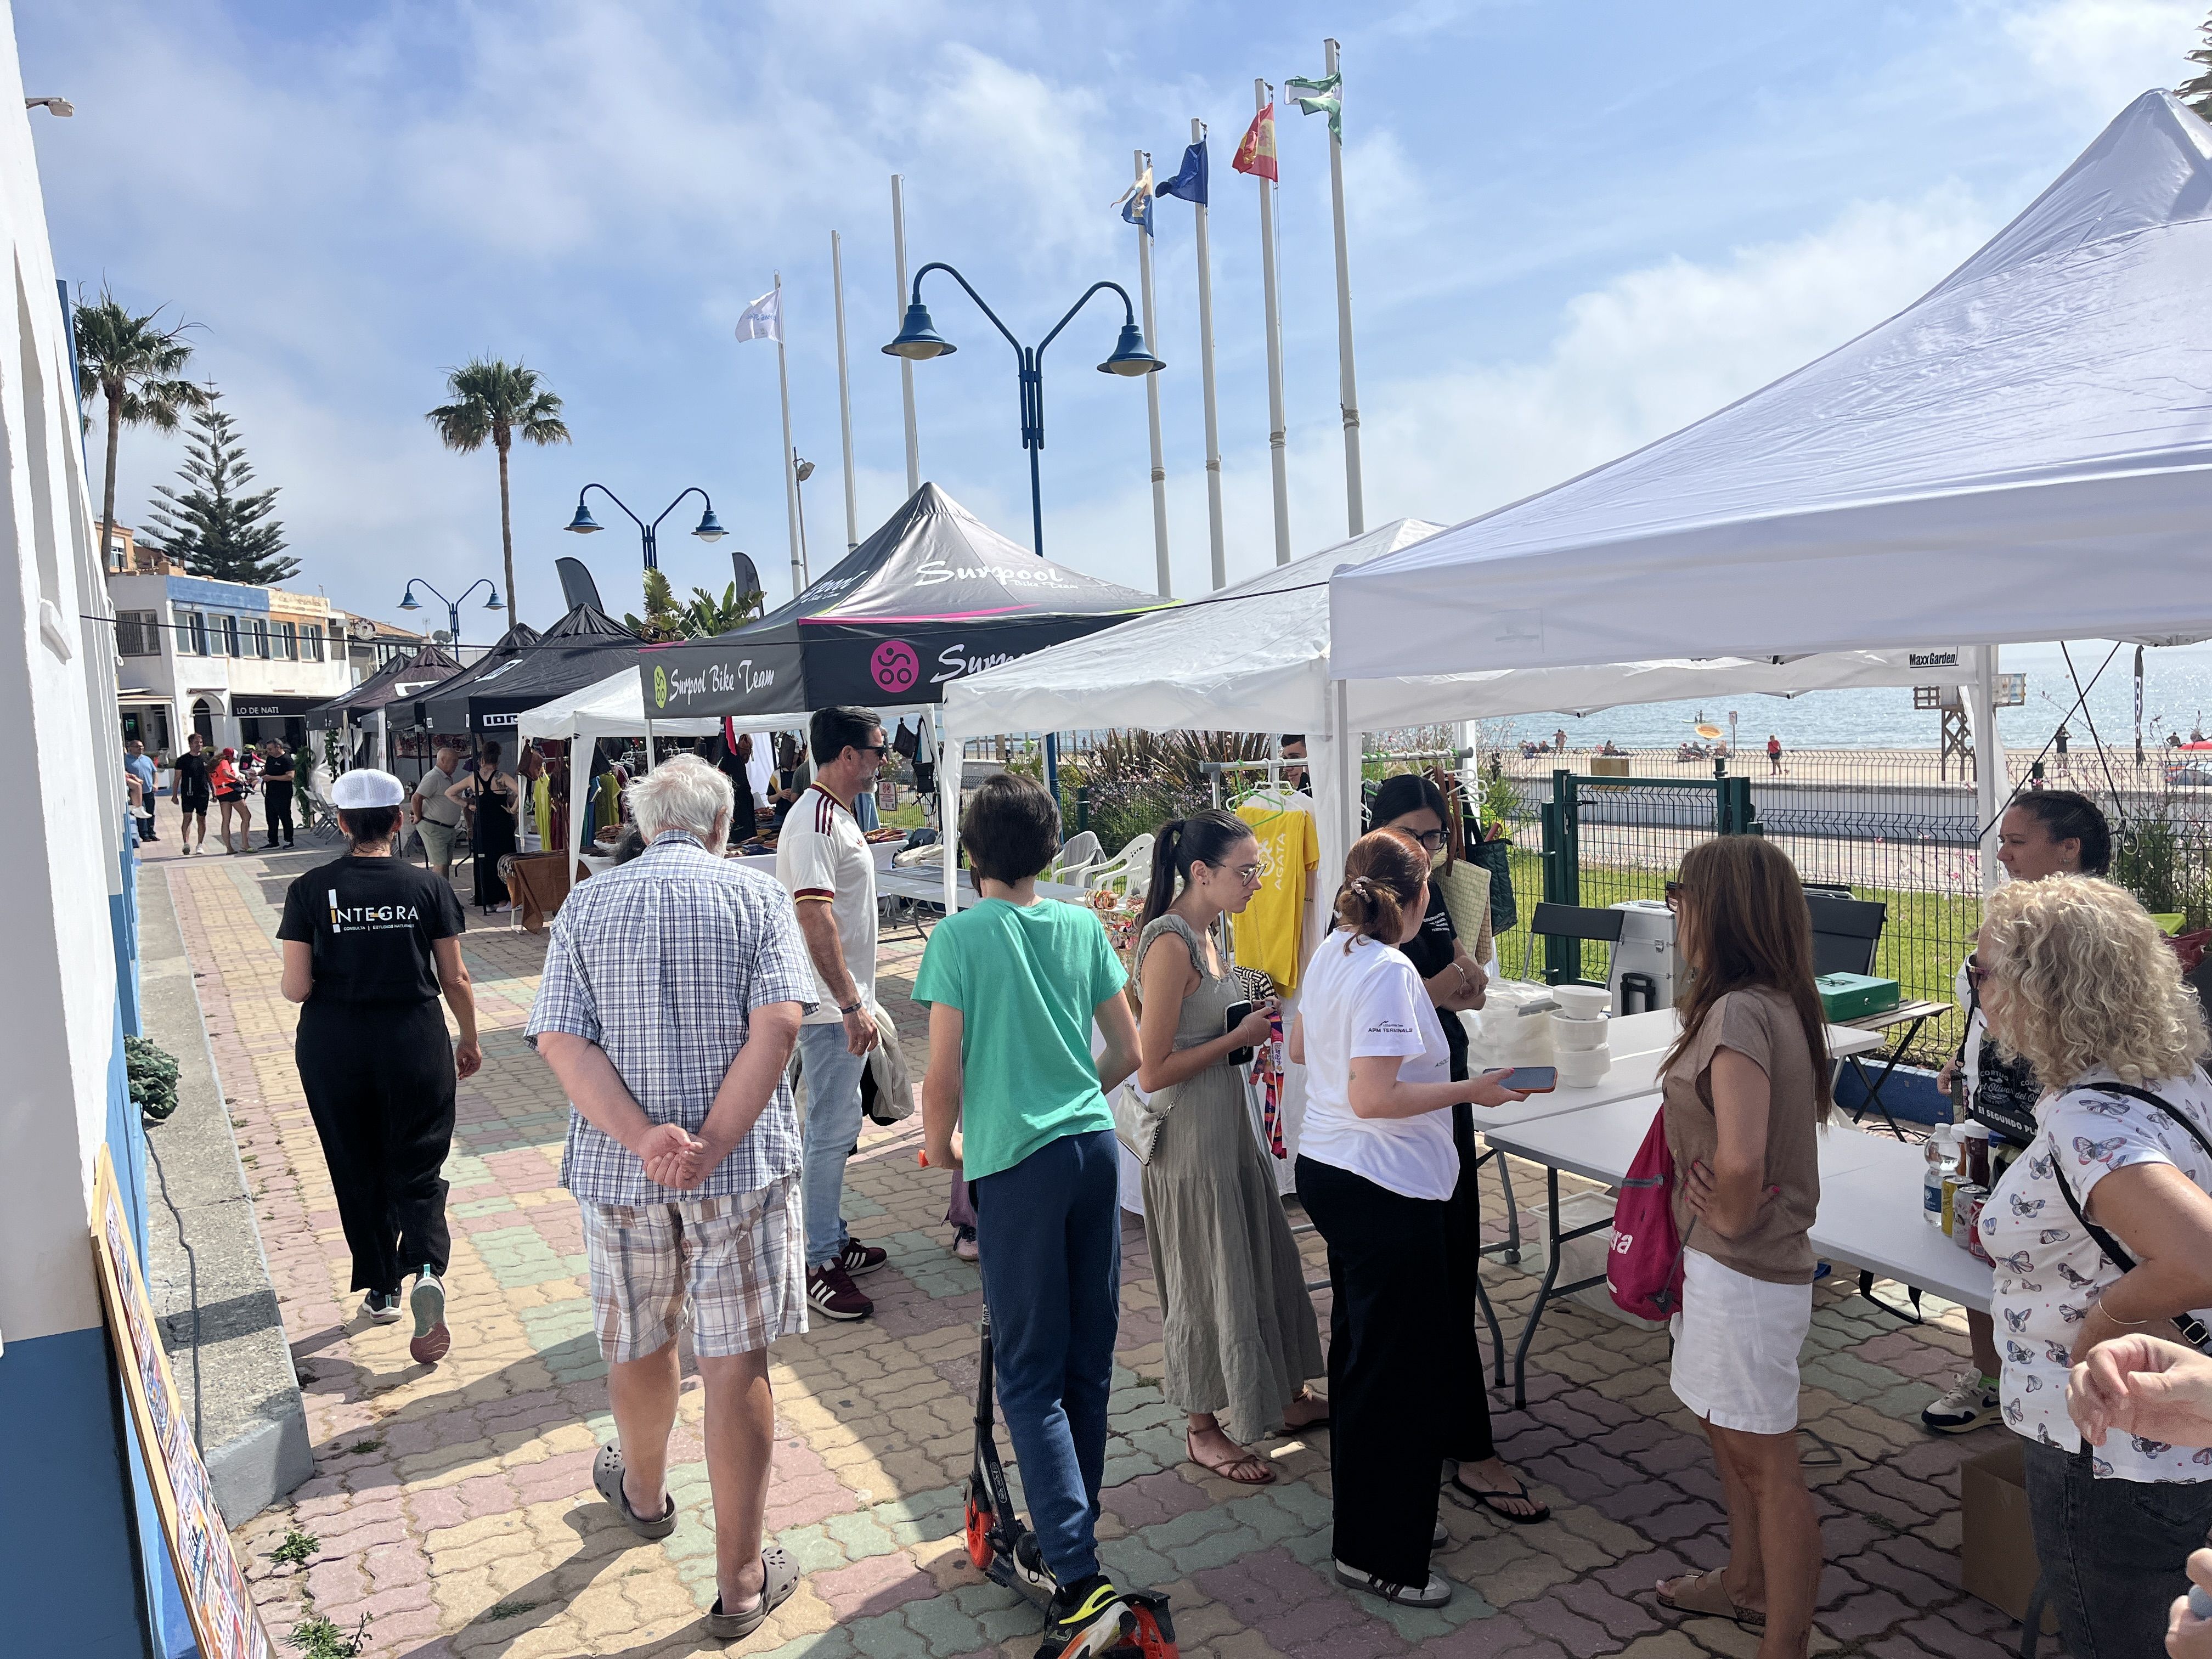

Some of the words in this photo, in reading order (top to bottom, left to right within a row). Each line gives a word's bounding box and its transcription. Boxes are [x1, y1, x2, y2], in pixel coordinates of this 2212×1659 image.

[914, 561, 1063, 586] Surpool
[668, 668, 707, 706] Surpool
[709, 663, 735, 692] Bike
[737, 659, 775, 694] Team
[1274, 833, 1286, 890] AGATA
[328, 889, 419, 933] INTEGRA
[1986, 1109, 2023, 1131] SEGUNDO
